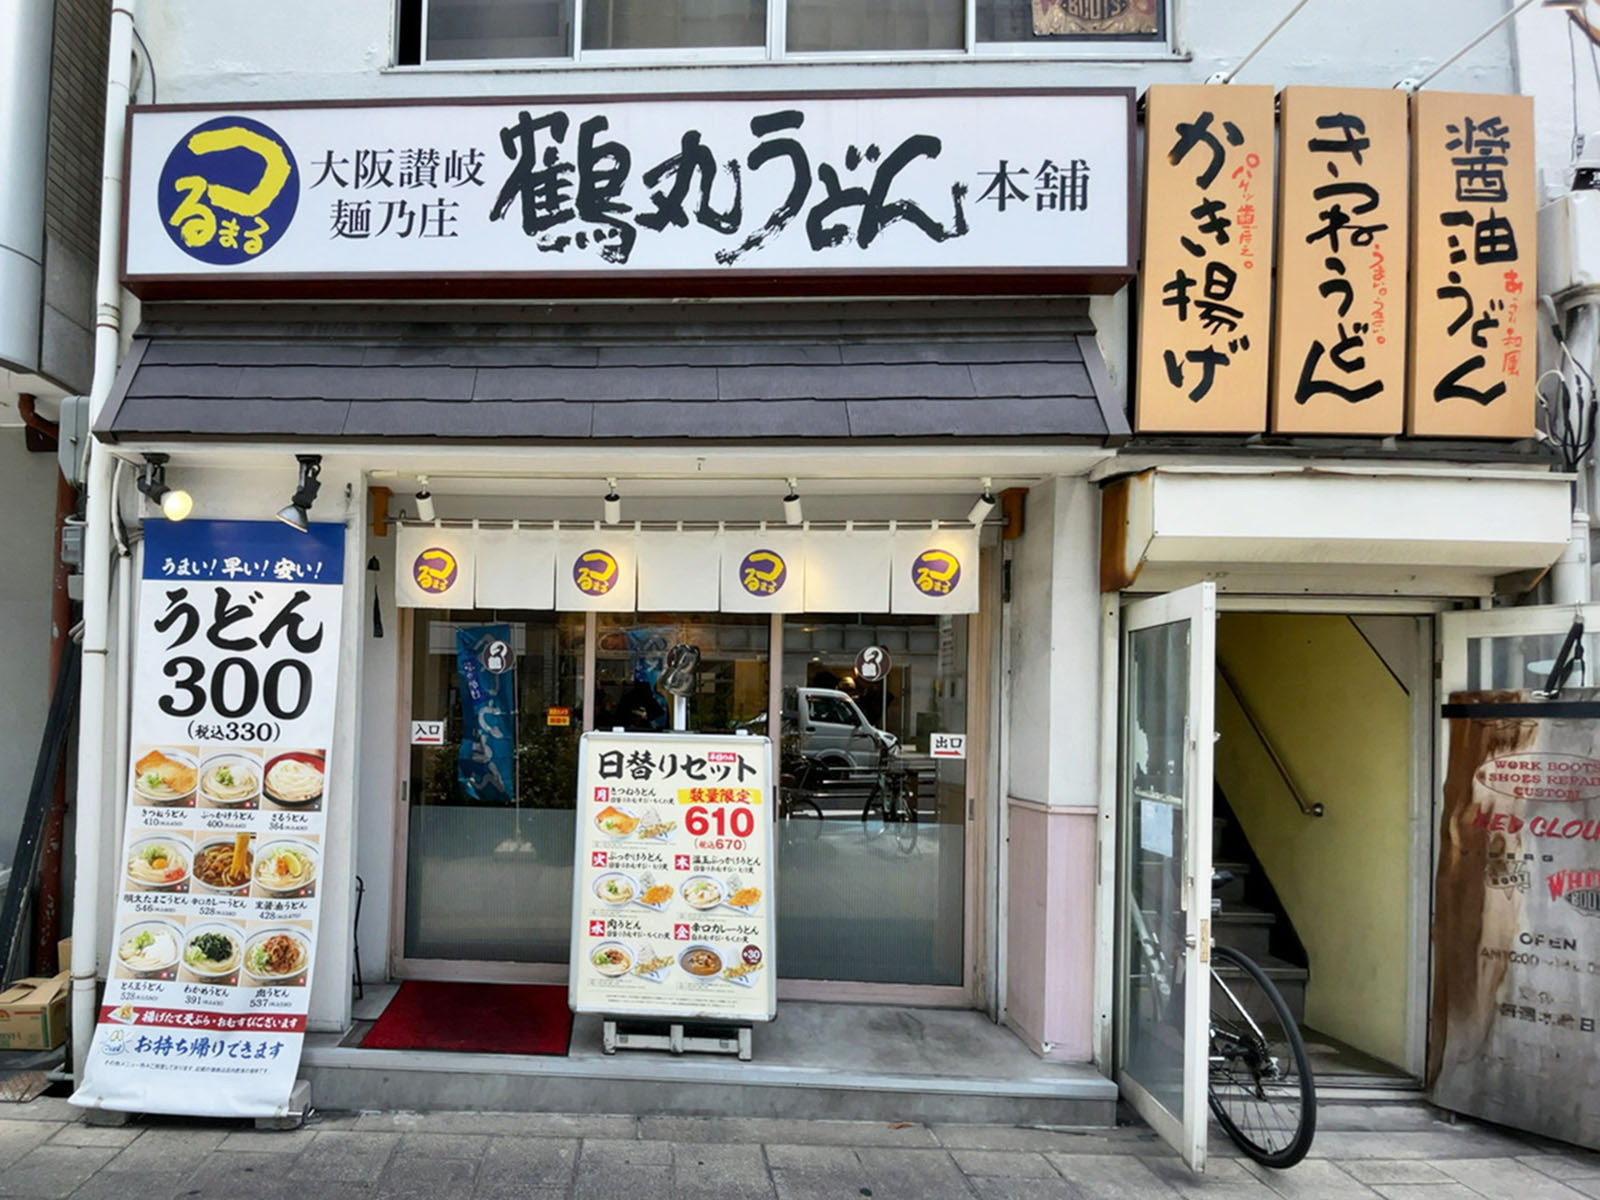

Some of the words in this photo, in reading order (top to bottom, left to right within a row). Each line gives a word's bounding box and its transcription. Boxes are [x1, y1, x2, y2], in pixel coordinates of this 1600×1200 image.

[168, 126, 292, 255] つるまる
[489, 110, 969, 267] 鶴丸うどん
[975, 158, 1091, 213] 本舗
[329, 198, 461, 240] 麺乃庄
[1162, 112, 1250, 403] かき揚げ
[1294, 112, 1388, 405] きつねうどん
[1434, 116, 1519, 406] 醤油うどん
[154, 586, 323, 654] うどん
[158, 656, 313, 720] 300
[187, 720, 281, 743] (税込330)
[415, 723, 440, 735] 入口
[935, 736, 963, 749] 出口
[598, 750, 757, 783] 日替りセット
[1494, 760, 1542, 771] WORK
[1489, 773, 1542, 784] SHOES
[611, 787, 656, 797] きつねうどん
[689, 787, 751, 805] 数量限定
[141, 808, 188, 820] きつねうどん
[201, 810, 255, 822] ぶっかけうどん
[271, 813, 309, 823] ざるうどん
[143, 818, 160, 826] 410
[206, 820, 223, 829] 400
[685, 805, 755, 838] 610
[593, 852, 607, 867] 火
[608, 852, 663, 862] ぶっかけうどん
[676, 856, 689, 870] 木
[607, 918, 642, 930] 肉うどん
[692, 922, 759, 935] 辛口カレーうどん
[184, 985, 229, 997] わかめうどん
[185, 995, 201, 1005] 391
[249, 999, 268, 1008] 537
[135, 1034, 285, 1060] お持ち帰りできます
